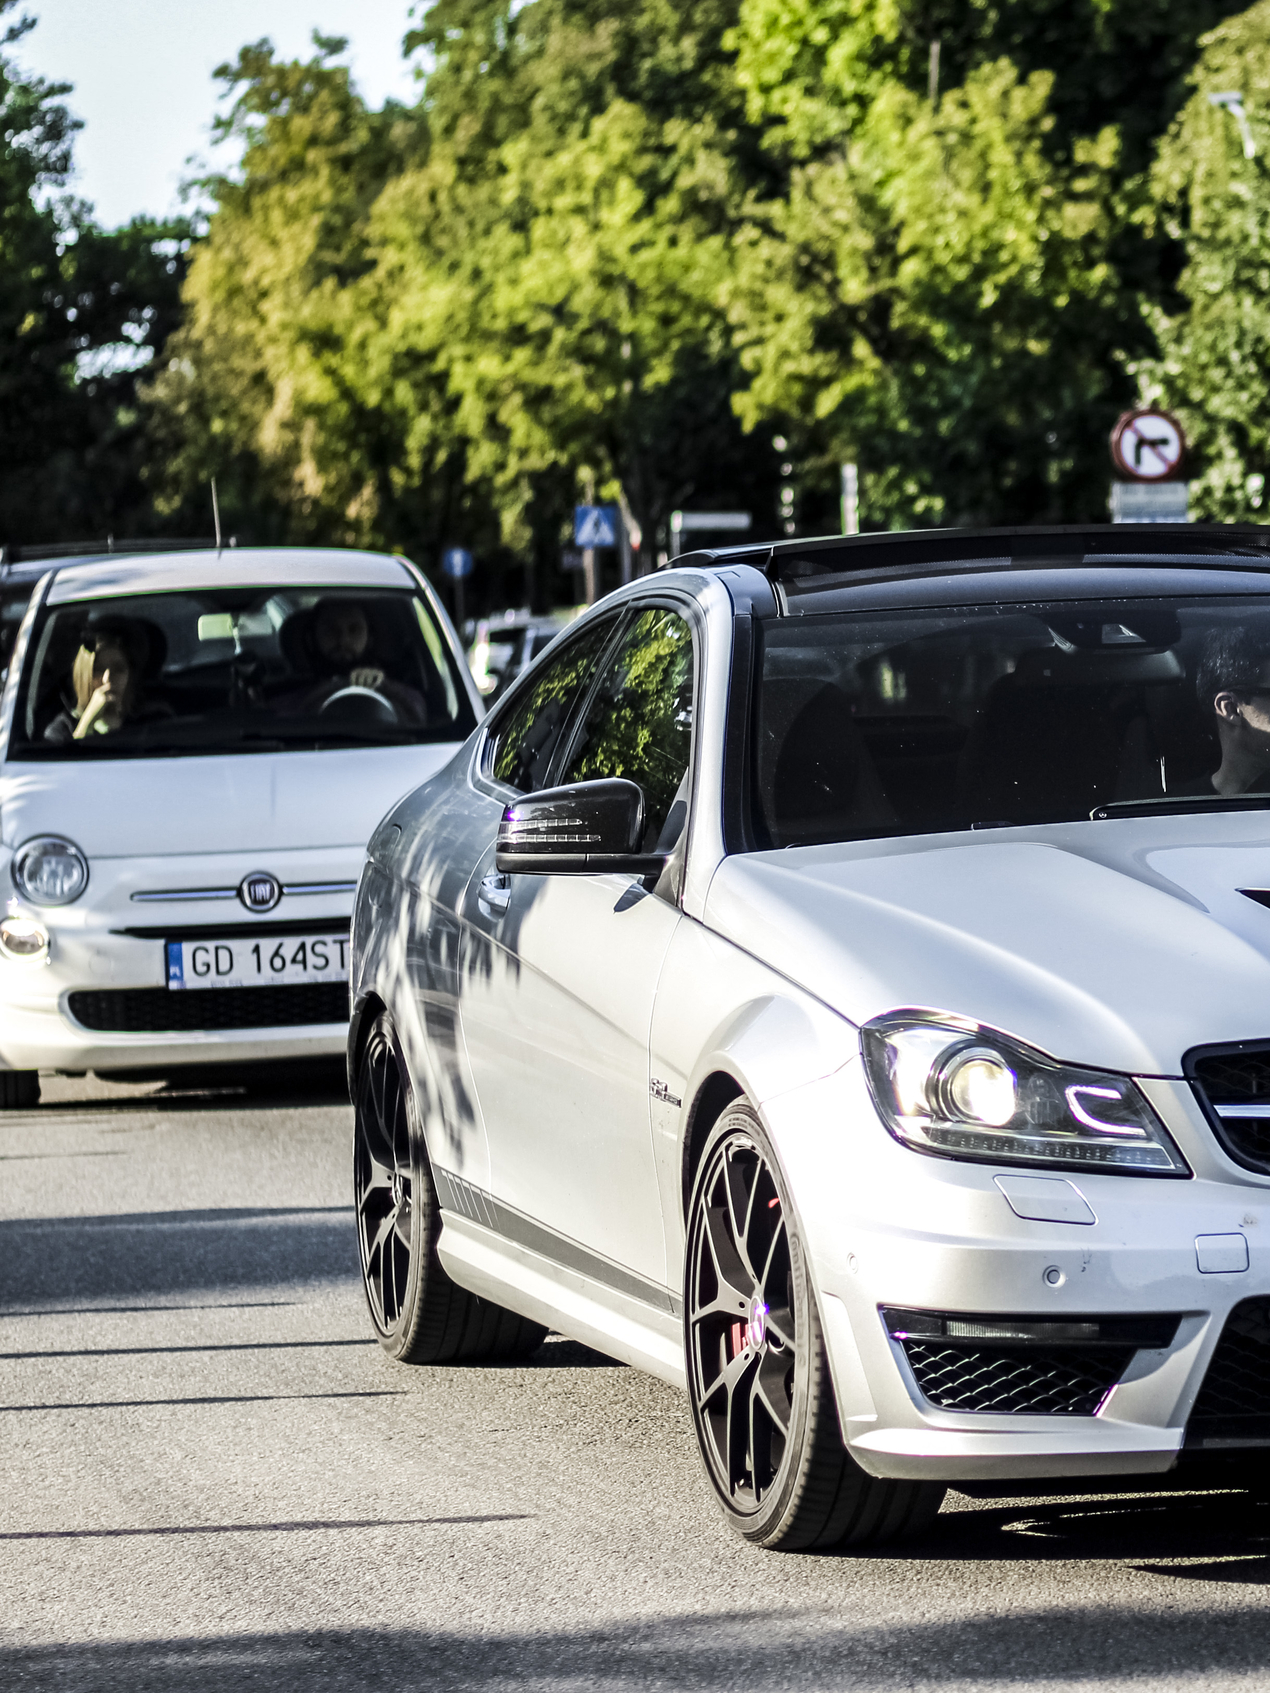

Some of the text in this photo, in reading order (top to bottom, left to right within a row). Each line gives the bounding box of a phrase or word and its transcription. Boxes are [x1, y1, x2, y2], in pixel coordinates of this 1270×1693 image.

[250, 883, 271, 901] FIAT
[192, 940, 350, 977] GD 164ST
